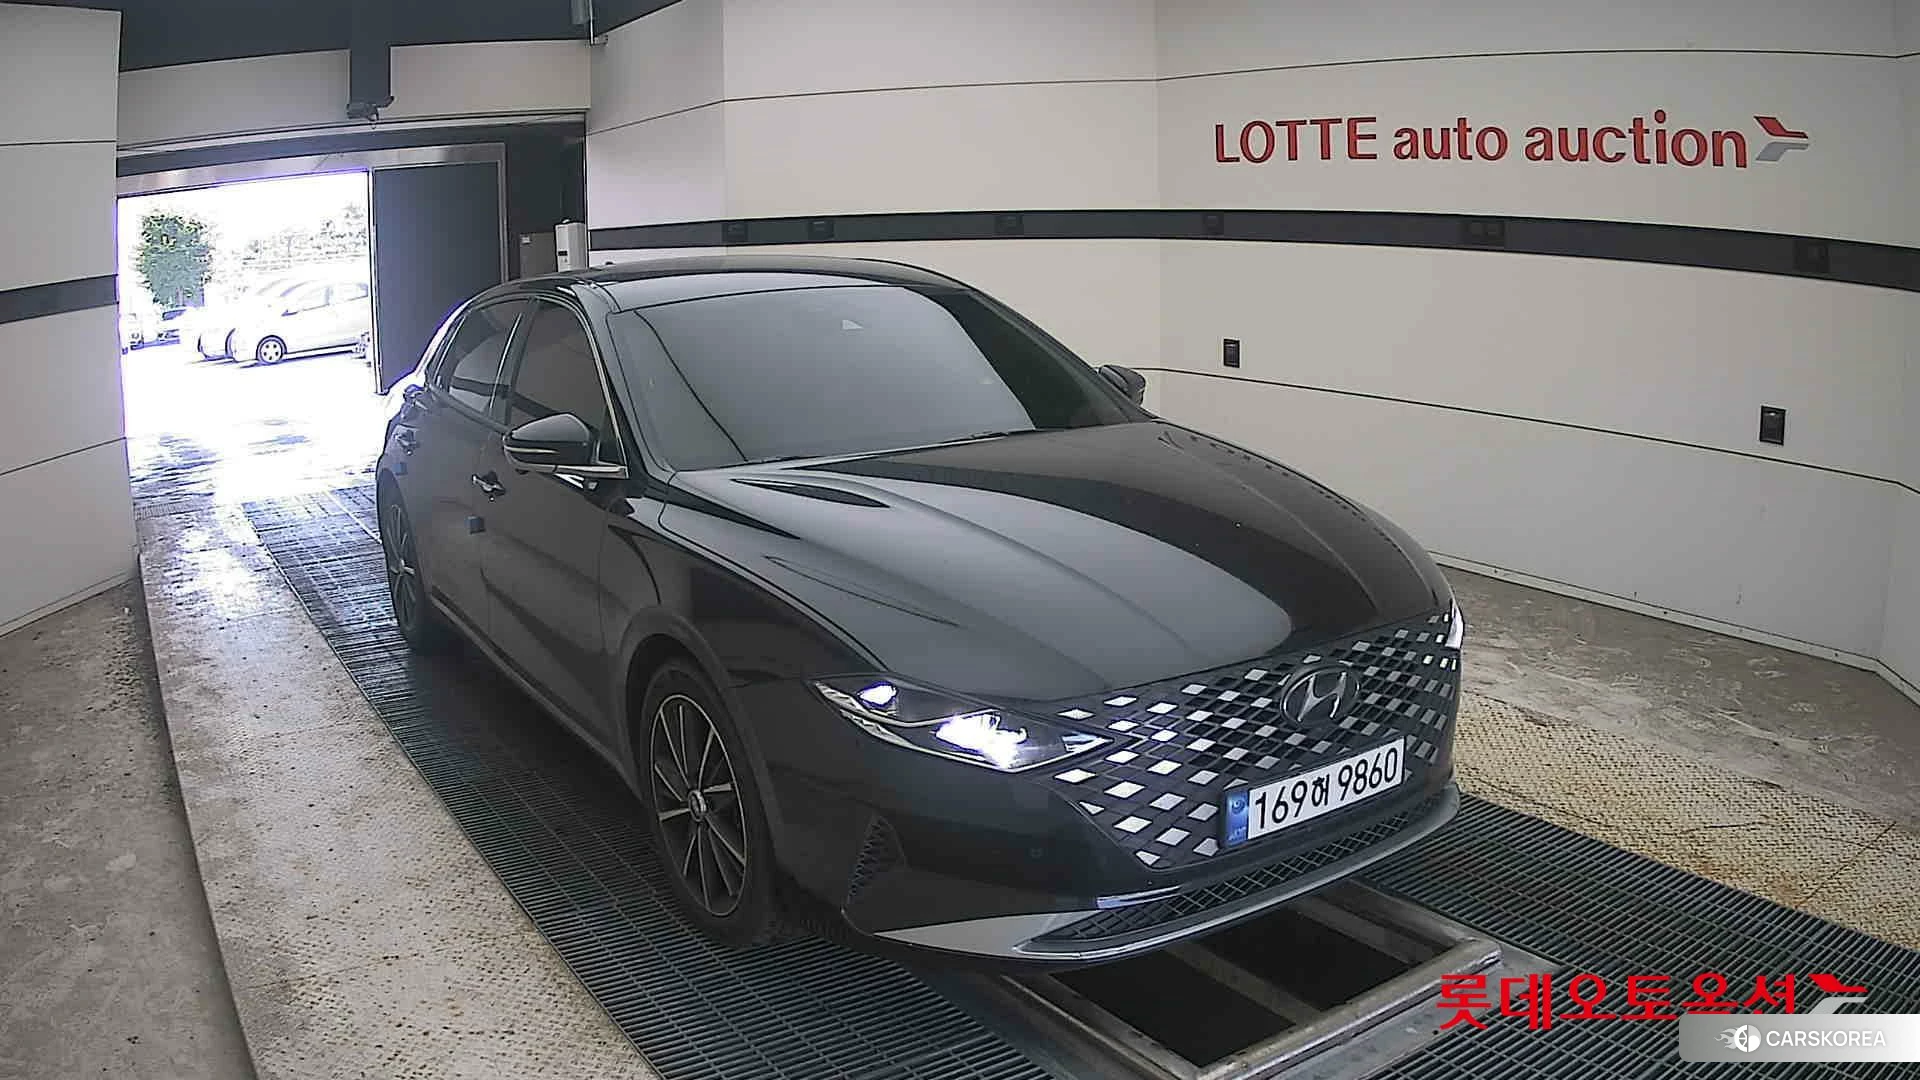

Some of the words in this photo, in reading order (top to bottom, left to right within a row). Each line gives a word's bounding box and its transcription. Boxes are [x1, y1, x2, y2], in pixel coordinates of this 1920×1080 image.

[1214, 116, 1378, 164] LOTTE
[1392, 116, 1509, 161] auto
[1524, 109, 1749, 169] auction
[1255, 773, 1331, 829] 169허
[1337, 747, 1399, 801] 9860
